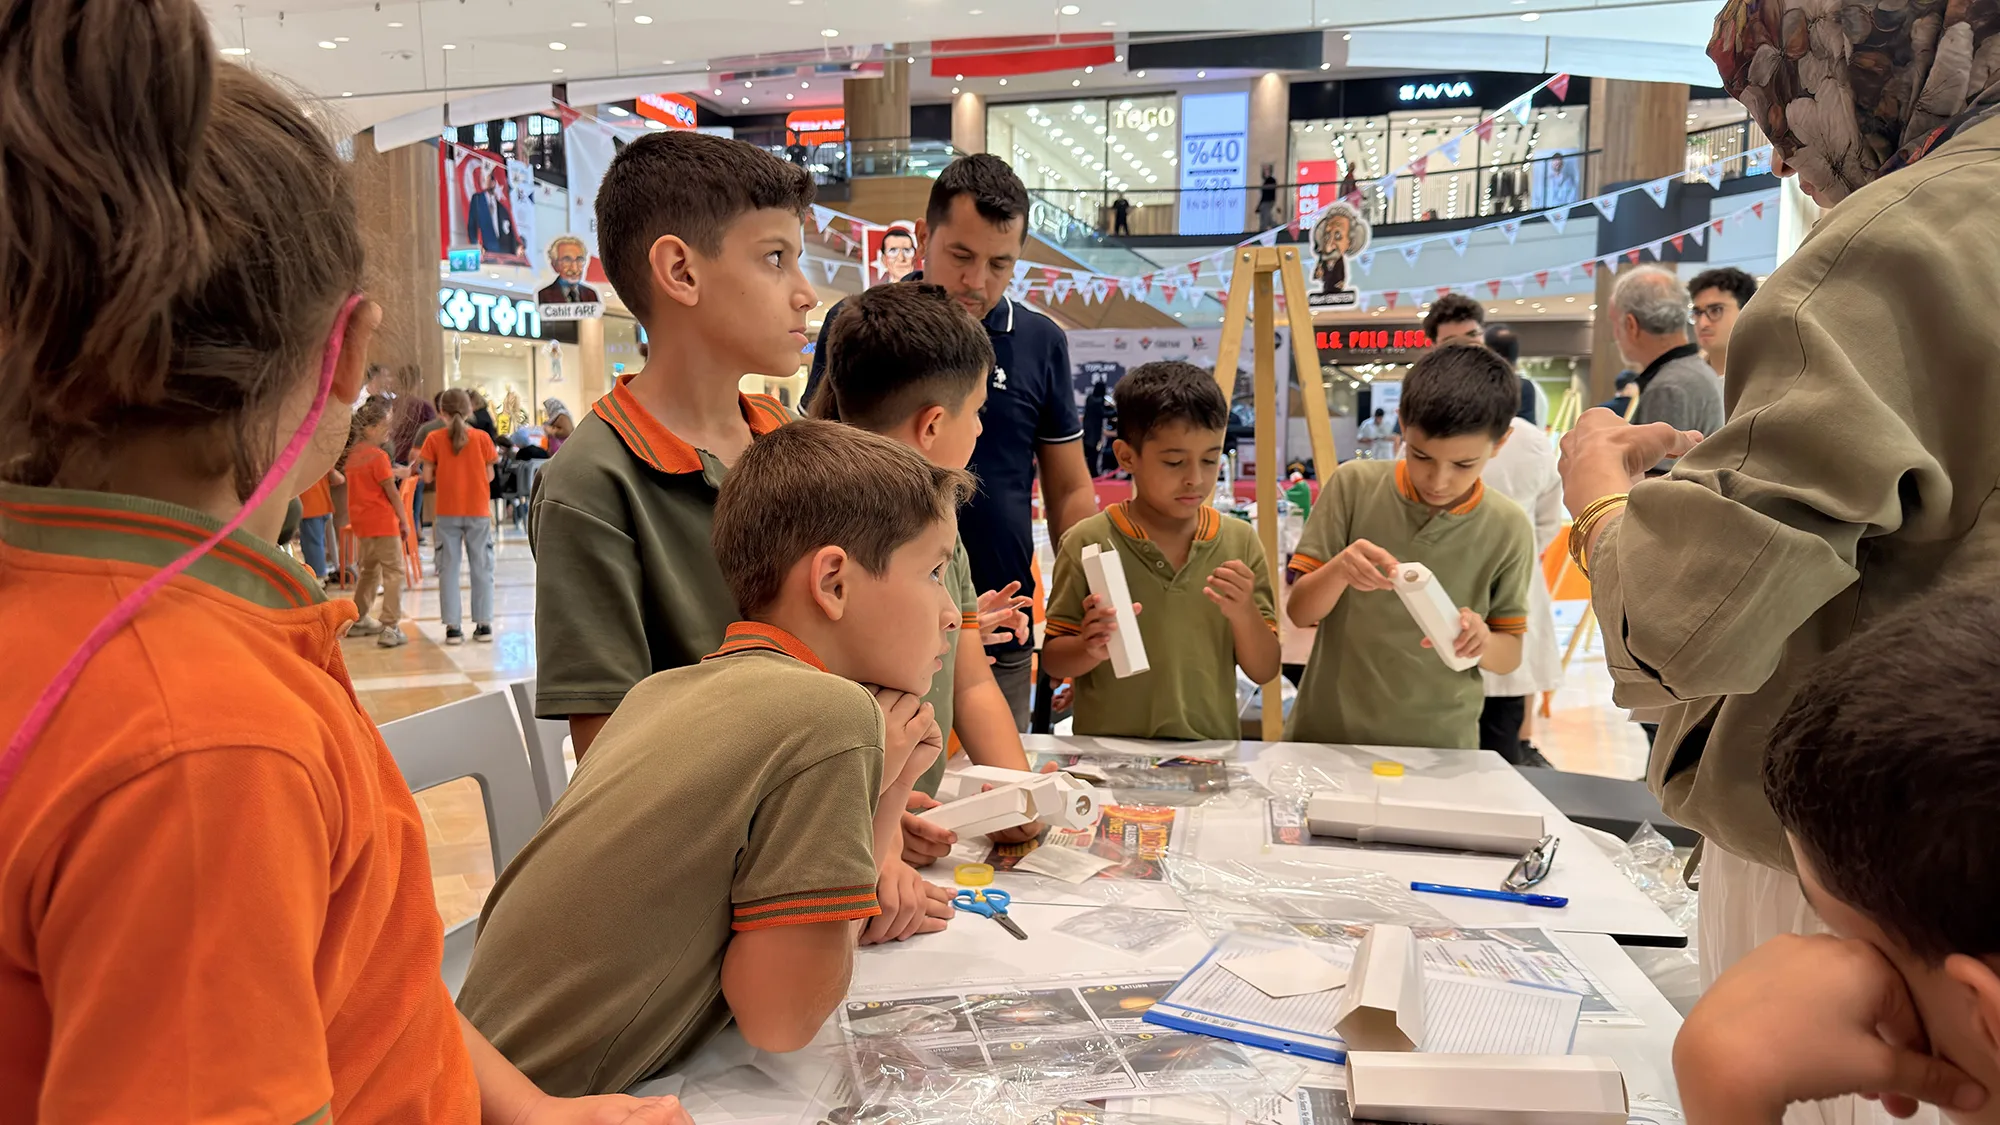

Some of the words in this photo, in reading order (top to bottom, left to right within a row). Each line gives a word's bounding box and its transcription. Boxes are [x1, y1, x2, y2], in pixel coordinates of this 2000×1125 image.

[1399, 82, 1474, 101] SAVVA
[1113, 106, 1176, 129] TOGO
[1187, 139, 1240, 165] %40
[544, 305, 572, 318] Cahit
[574, 304, 597, 316] ARF
[1349, 330, 1388, 349] POLO
